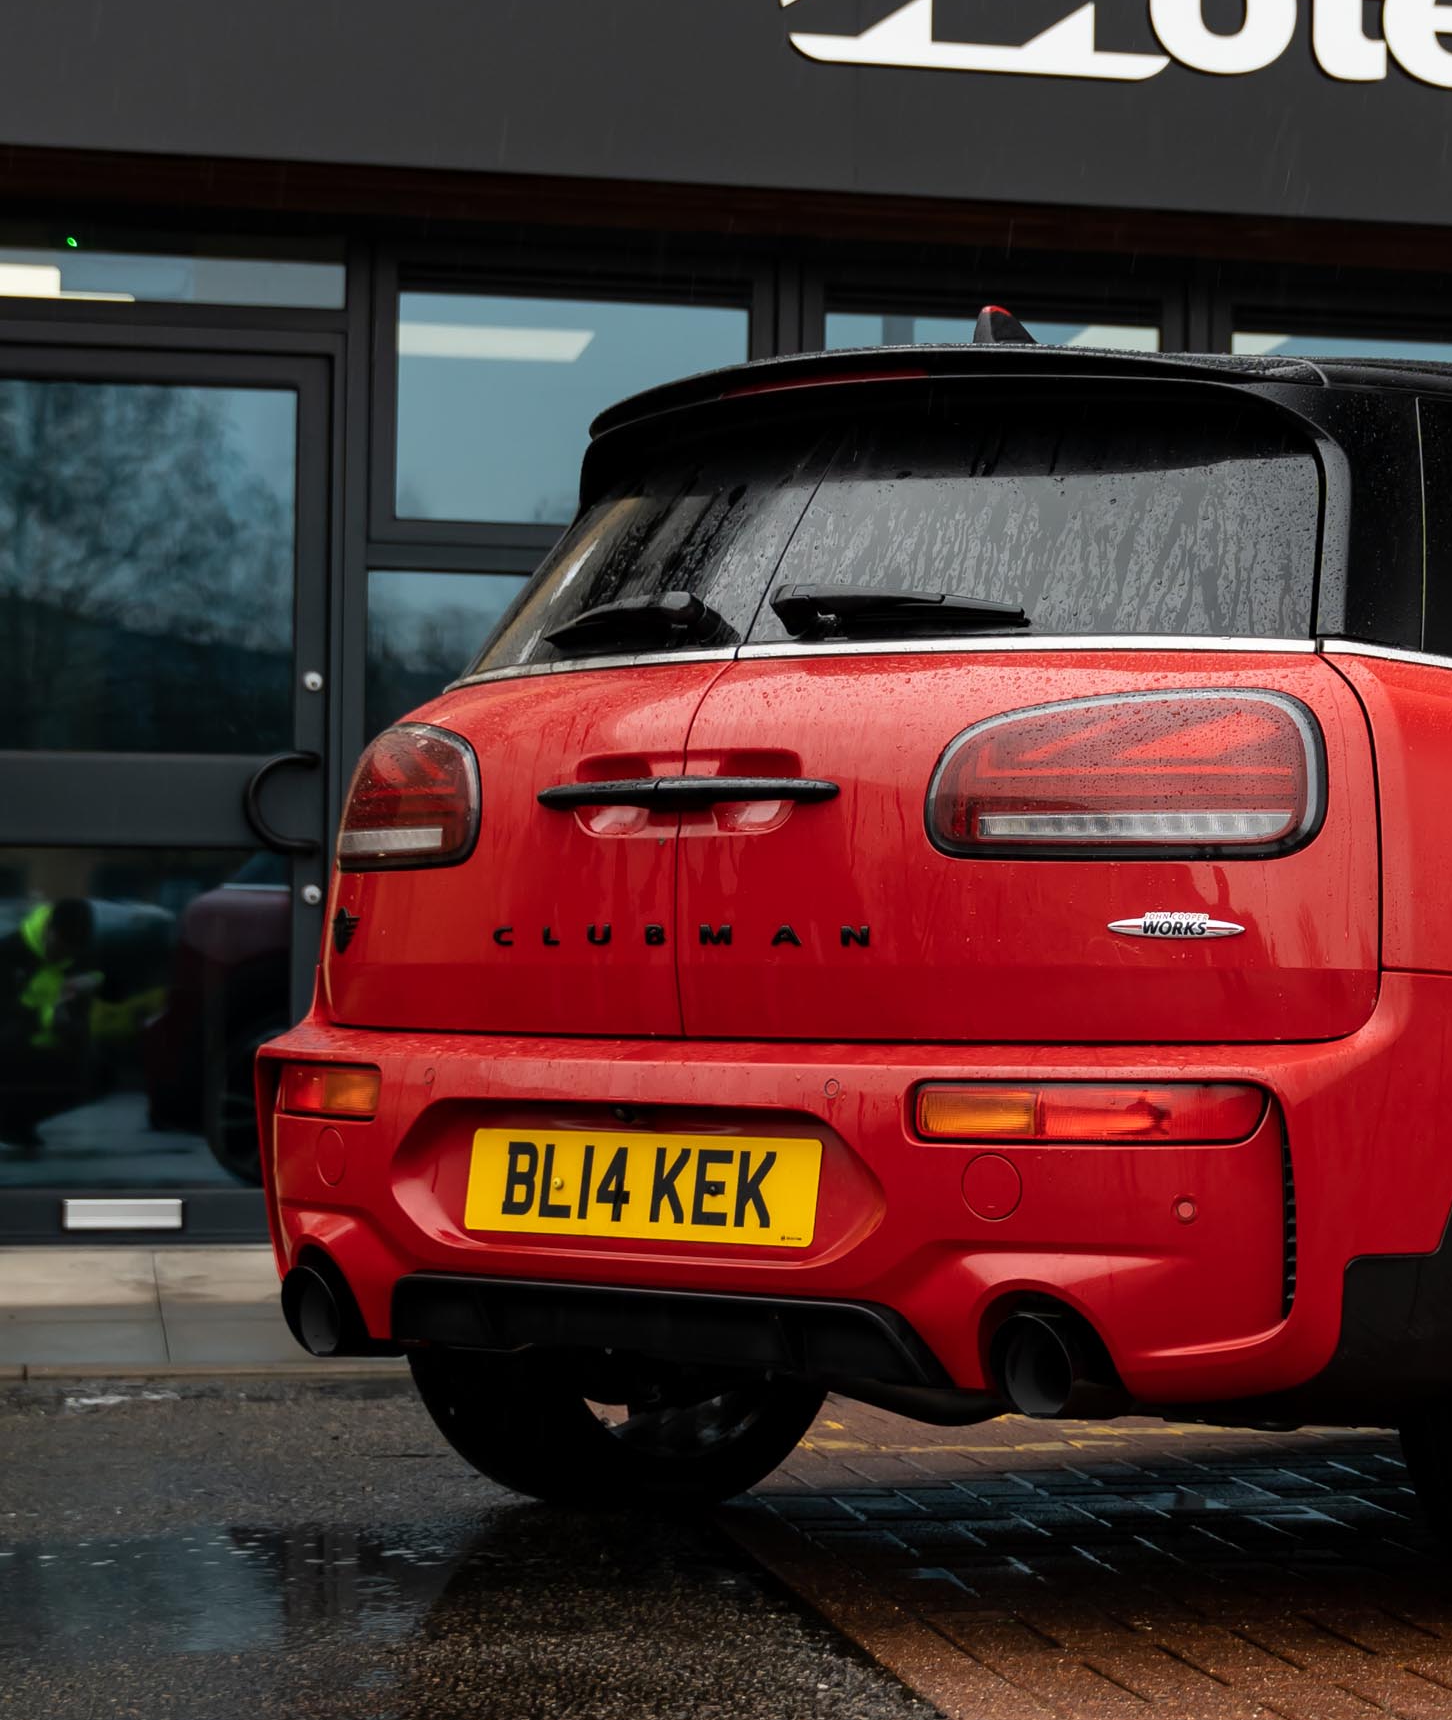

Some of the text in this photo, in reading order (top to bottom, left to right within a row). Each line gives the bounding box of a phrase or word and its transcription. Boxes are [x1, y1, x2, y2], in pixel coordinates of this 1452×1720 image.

[1144, 912, 1209, 922] JOHN COOPER
[493, 923, 871, 947] CLUBMAN
[1142, 920, 1207, 936] WORKS
[501, 1141, 777, 1228] BL14 KEK
